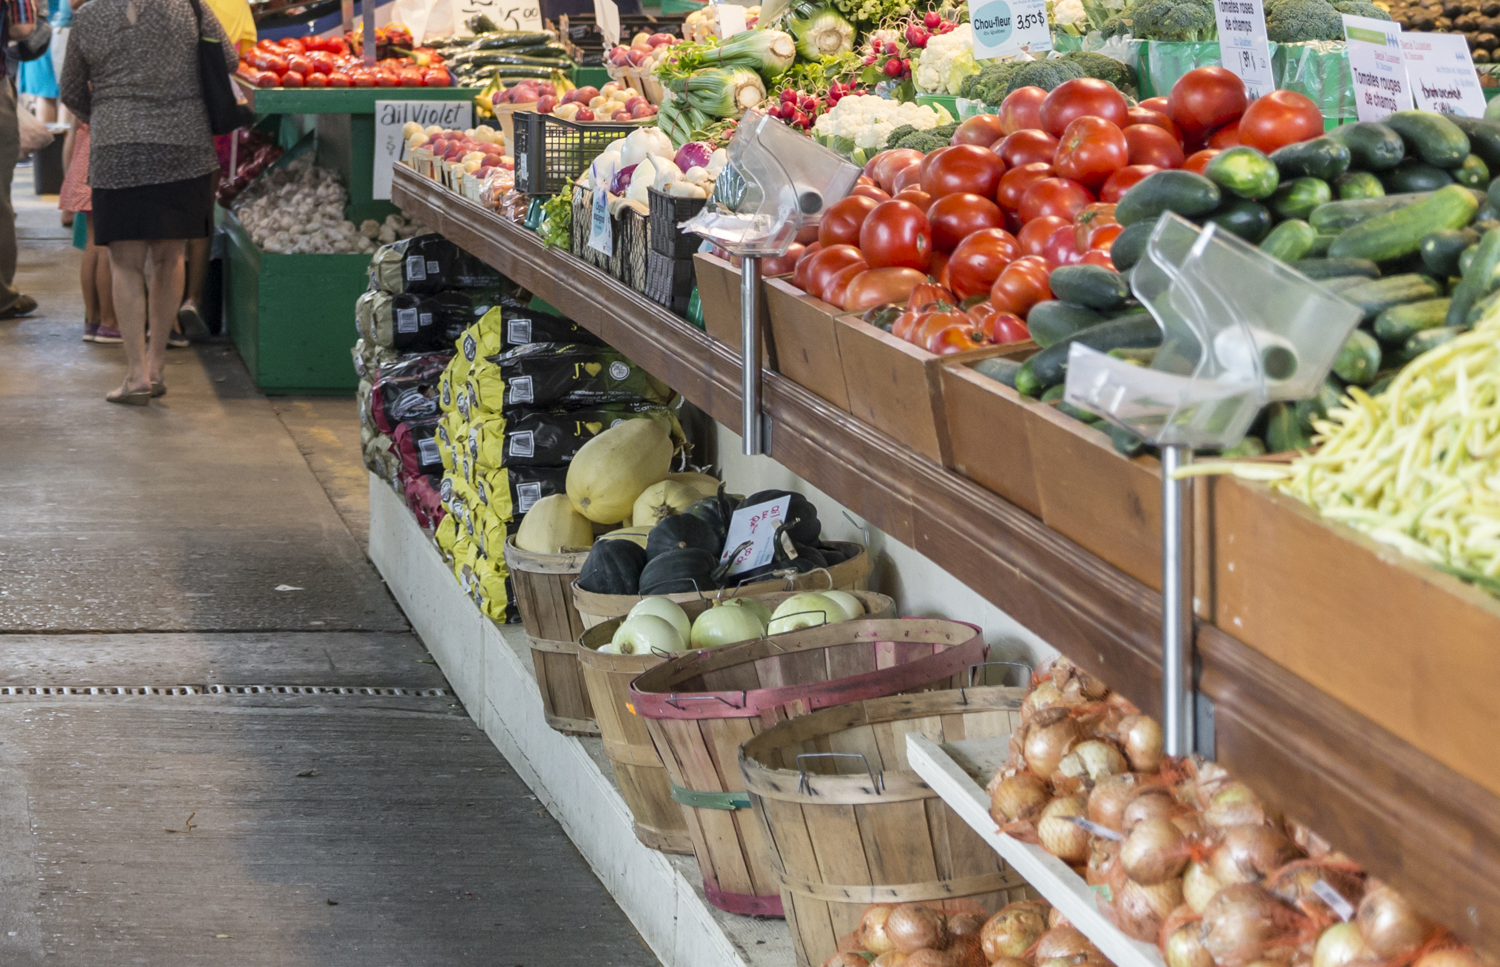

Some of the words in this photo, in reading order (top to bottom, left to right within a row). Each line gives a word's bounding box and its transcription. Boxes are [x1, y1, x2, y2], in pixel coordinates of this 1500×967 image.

[1240, 0, 1255, 15] roses
[974, 16, 1011, 30] Chou-fleur
[1224, 17, 1232, 32] de
[1232, 18, 1252, 36] champs
[1353, 67, 1380, 89] Tomates
[1380, 76, 1402, 96] rouges
[1364, 89, 1373, 105] de
[1373, 91, 1398, 114] champs
[381, 103, 408, 126] ail
